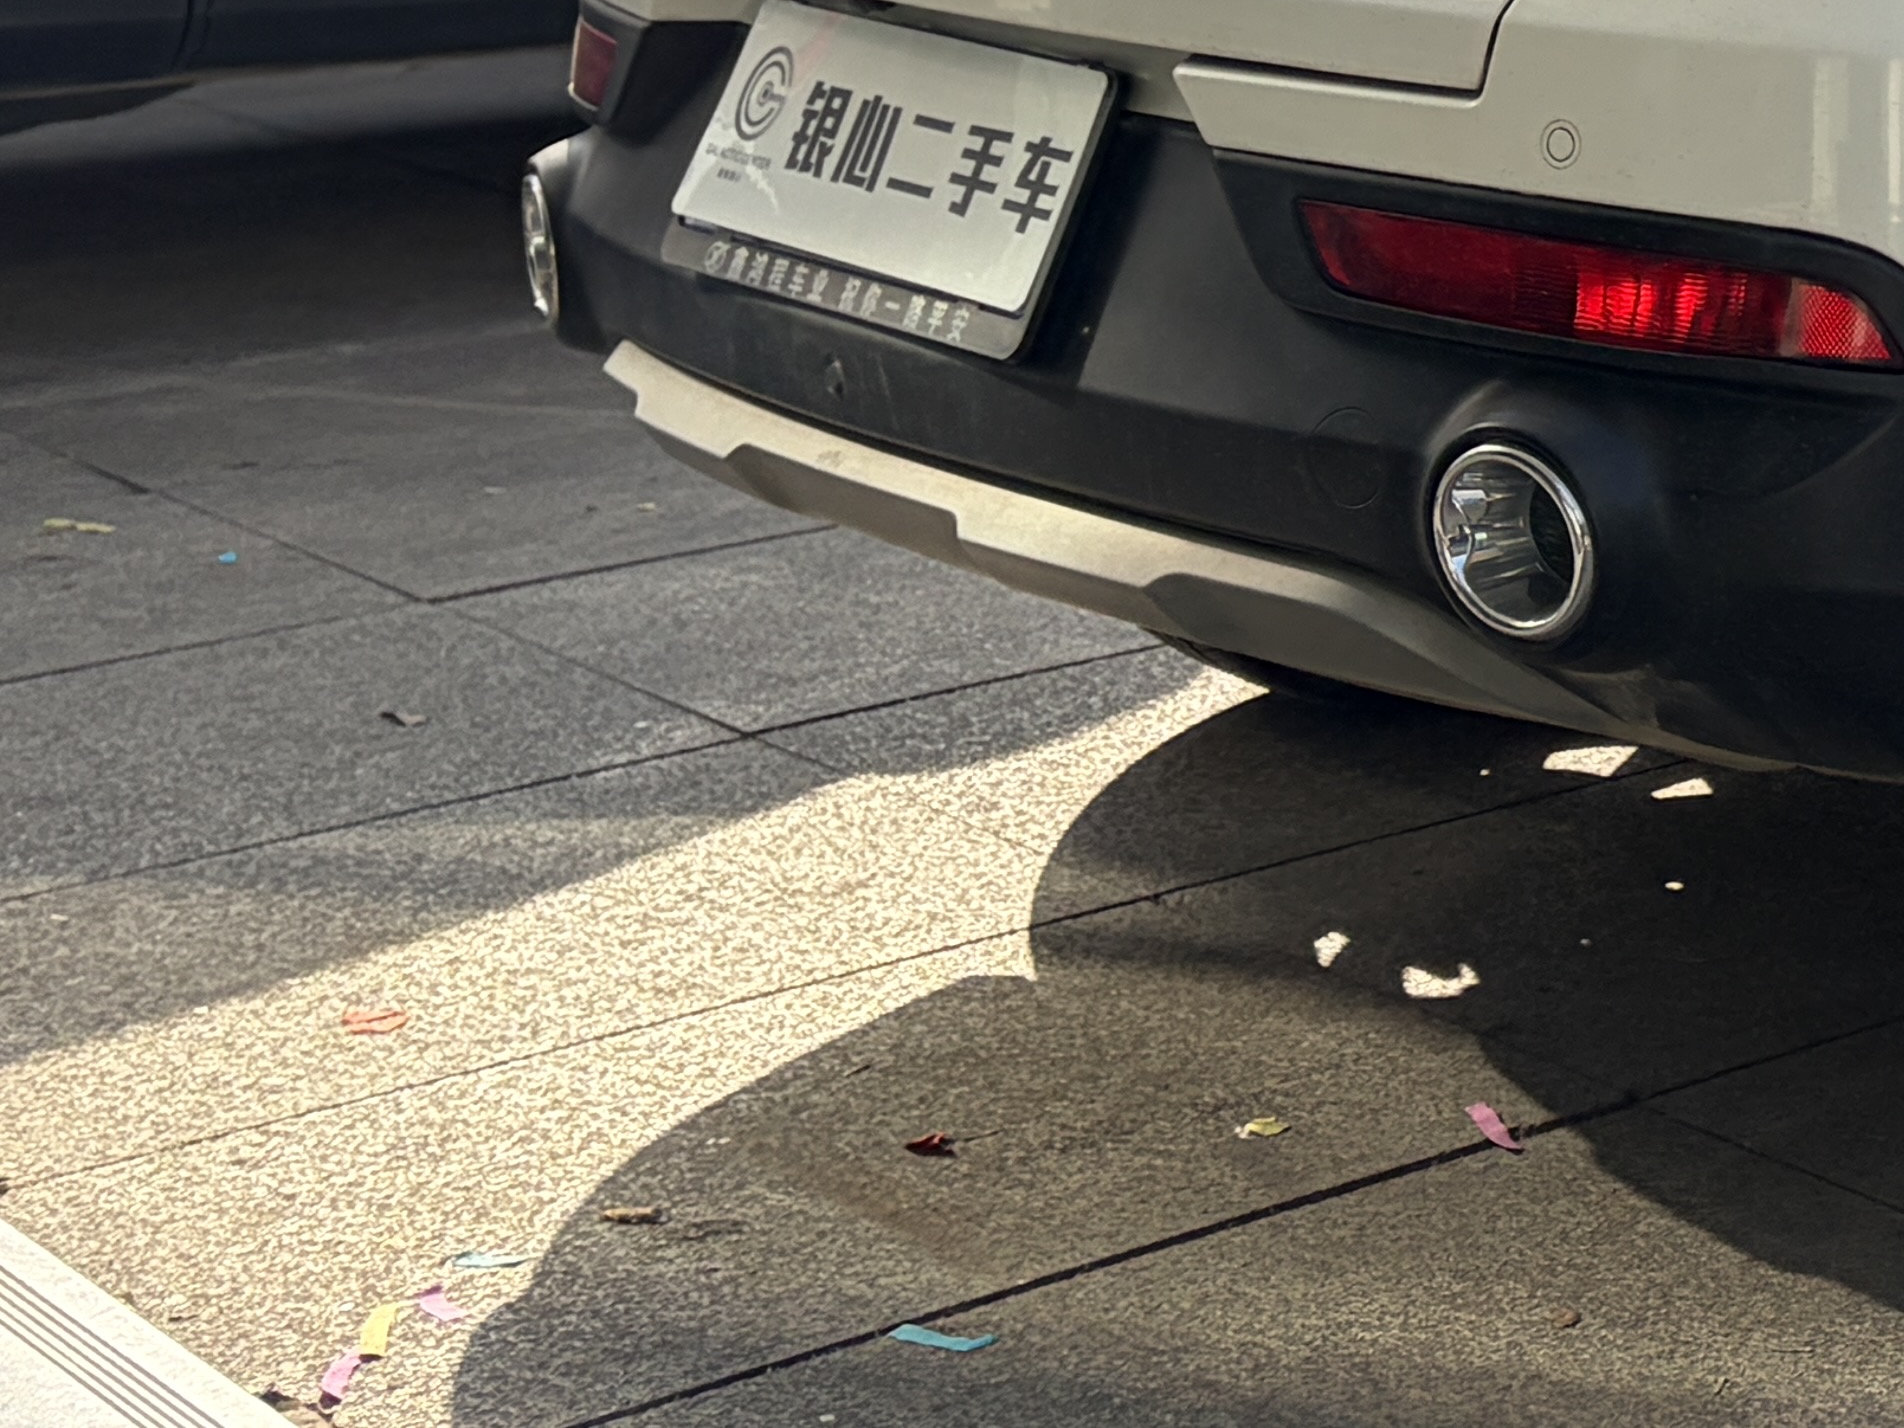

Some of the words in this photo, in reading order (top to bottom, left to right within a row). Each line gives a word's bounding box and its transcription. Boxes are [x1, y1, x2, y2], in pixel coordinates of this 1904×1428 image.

[784, 80, 1074, 235] 银心二手车
